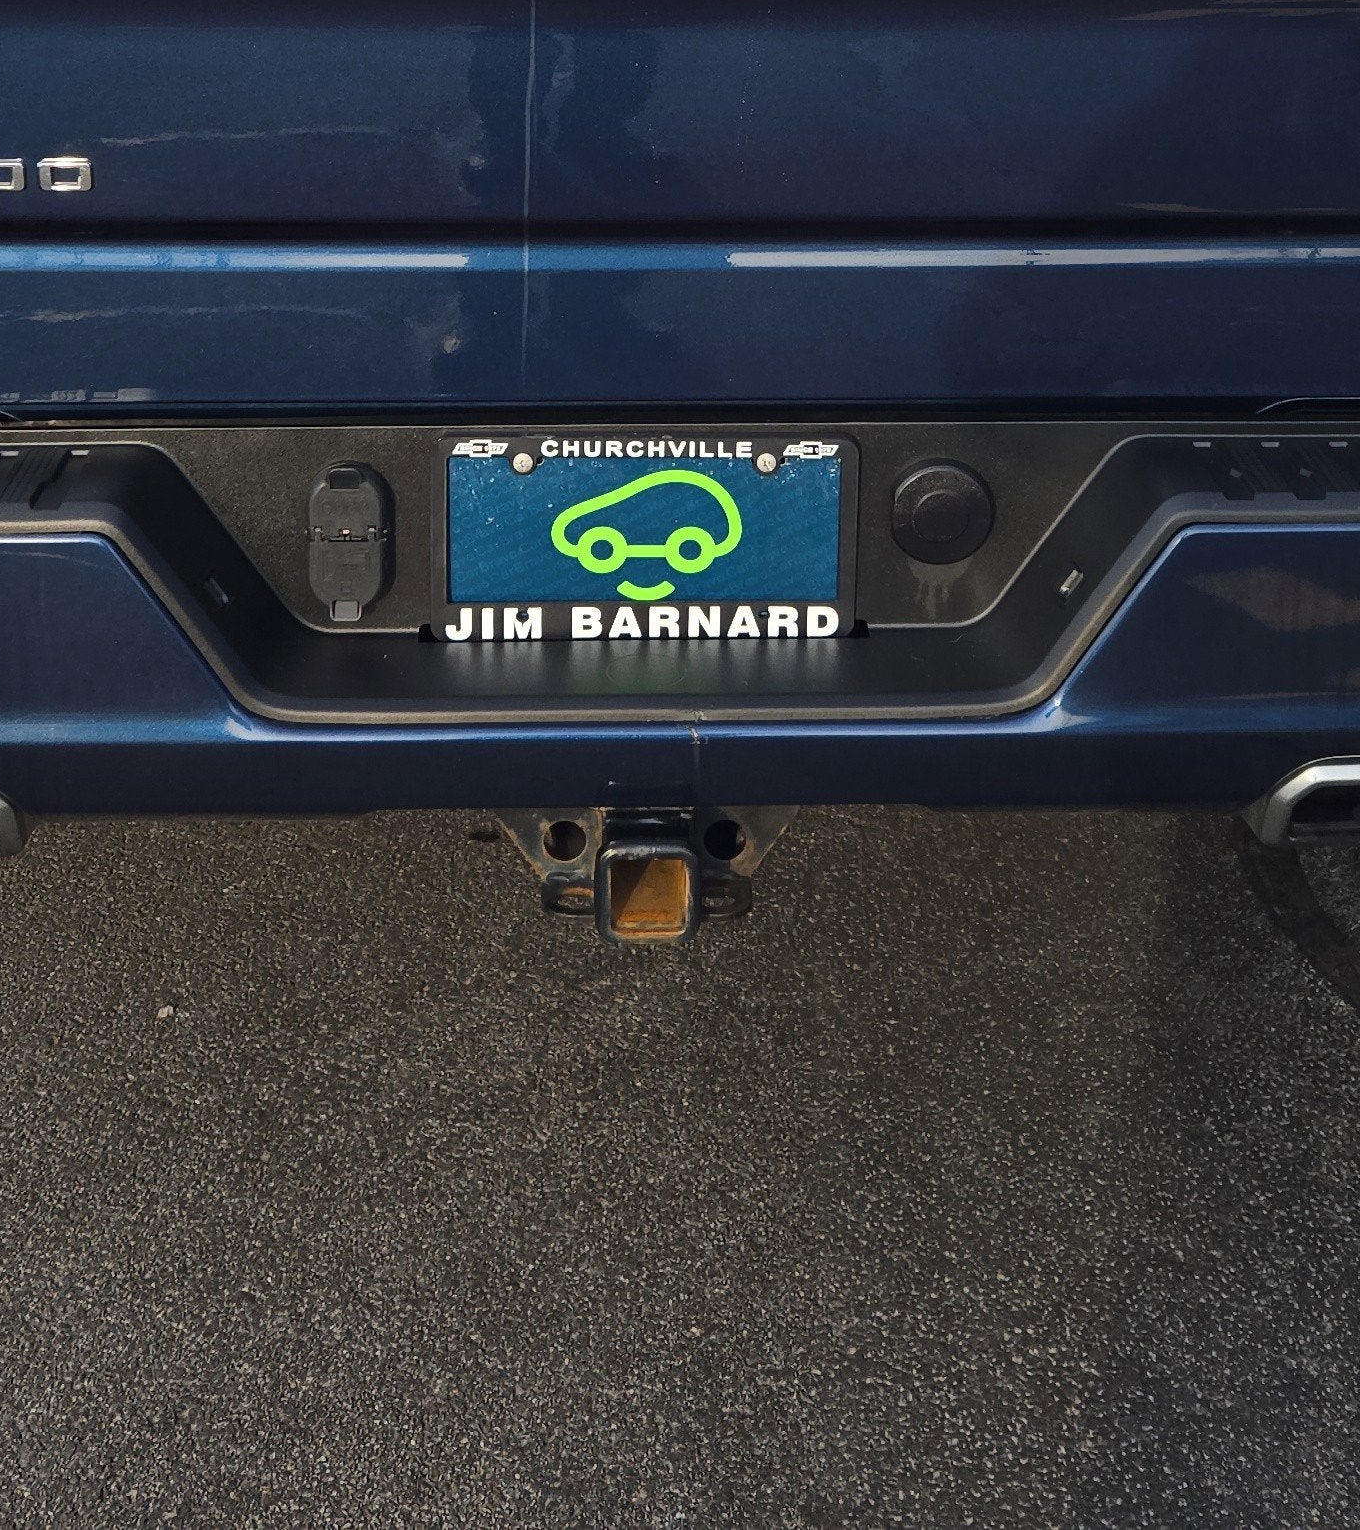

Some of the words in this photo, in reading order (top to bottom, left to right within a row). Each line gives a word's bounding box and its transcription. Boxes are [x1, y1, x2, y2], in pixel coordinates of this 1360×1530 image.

[540, 439, 753, 458] CHURCHVILLE
[445, 607, 542, 640] JIM
[572, 605, 839, 639] BARNARD
